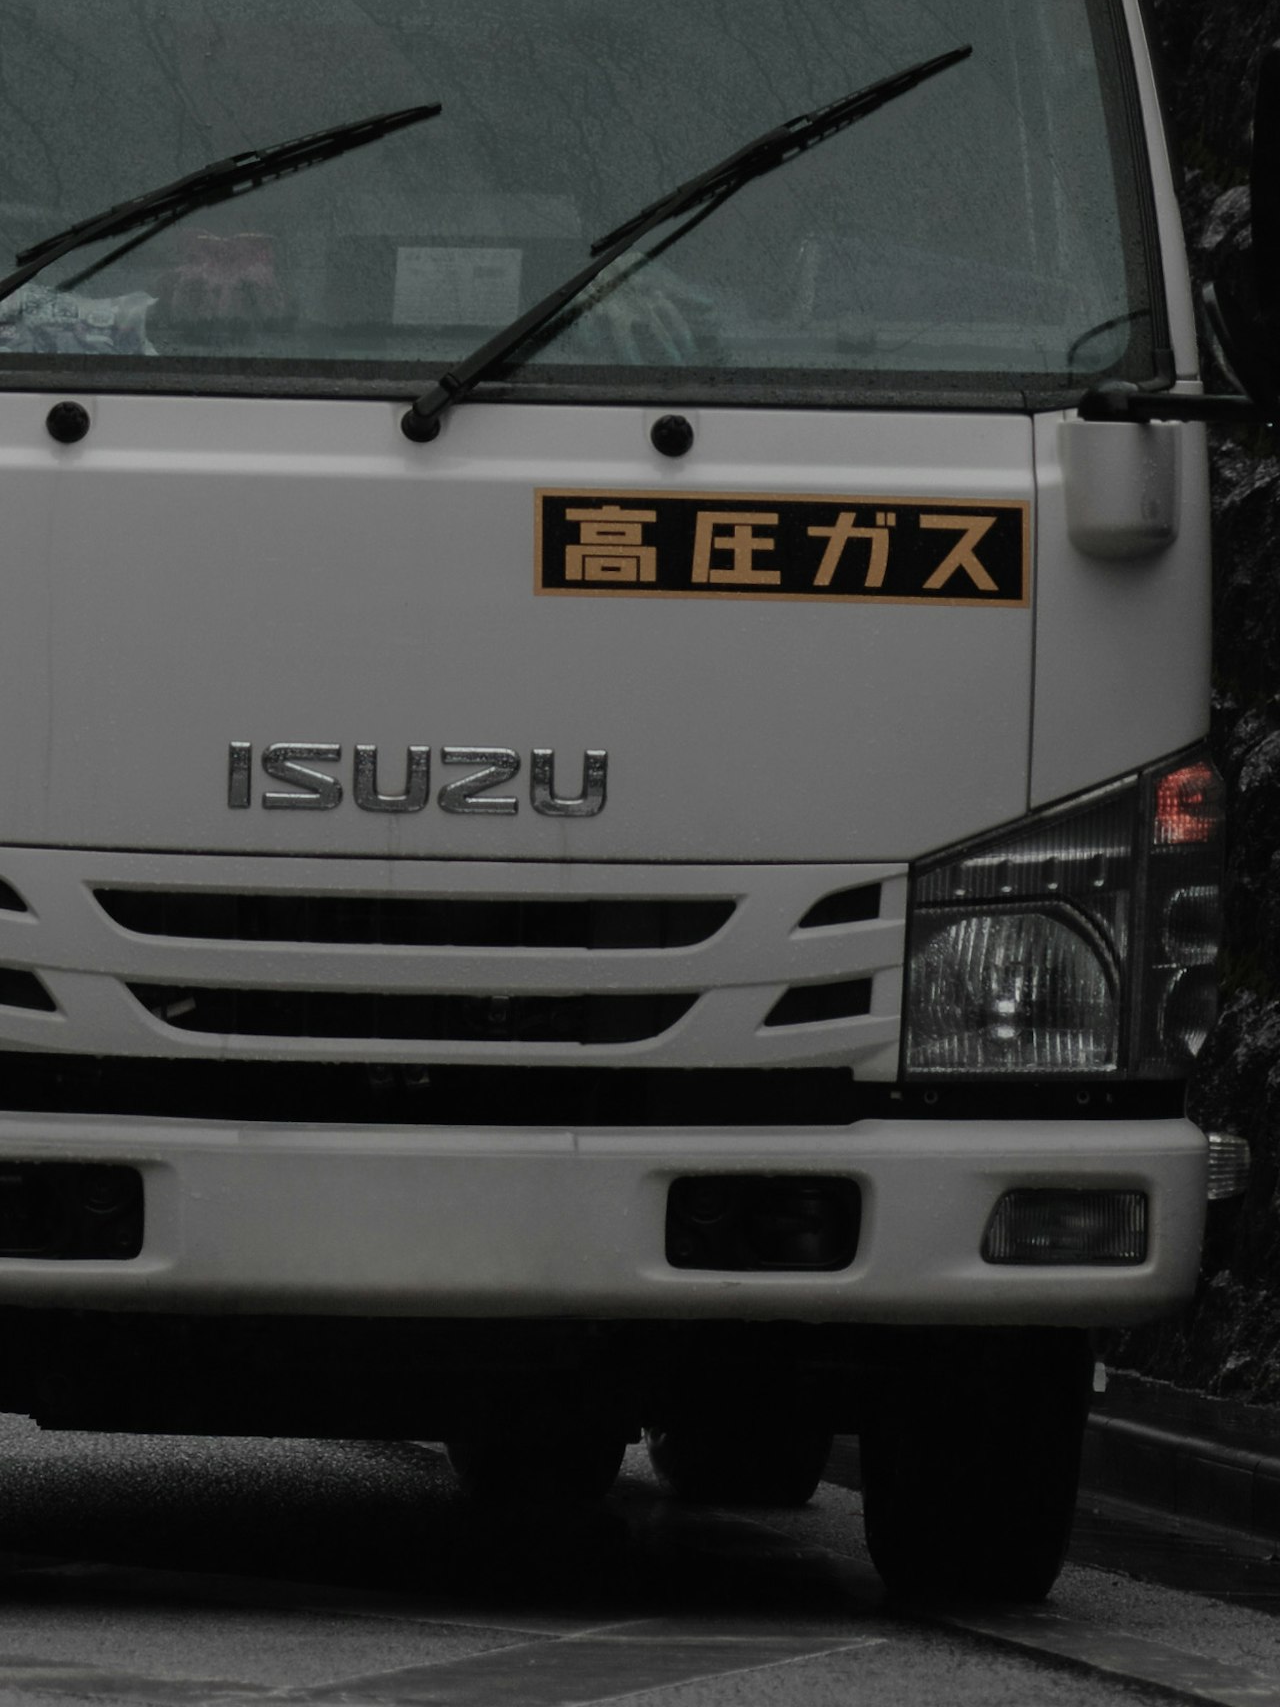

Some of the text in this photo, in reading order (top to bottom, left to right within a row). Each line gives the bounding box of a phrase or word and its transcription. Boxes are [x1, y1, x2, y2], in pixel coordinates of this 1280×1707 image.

[563, 504, 1001, 592] 高圧ガス
[228, 741, 609, 817] ISUZU
